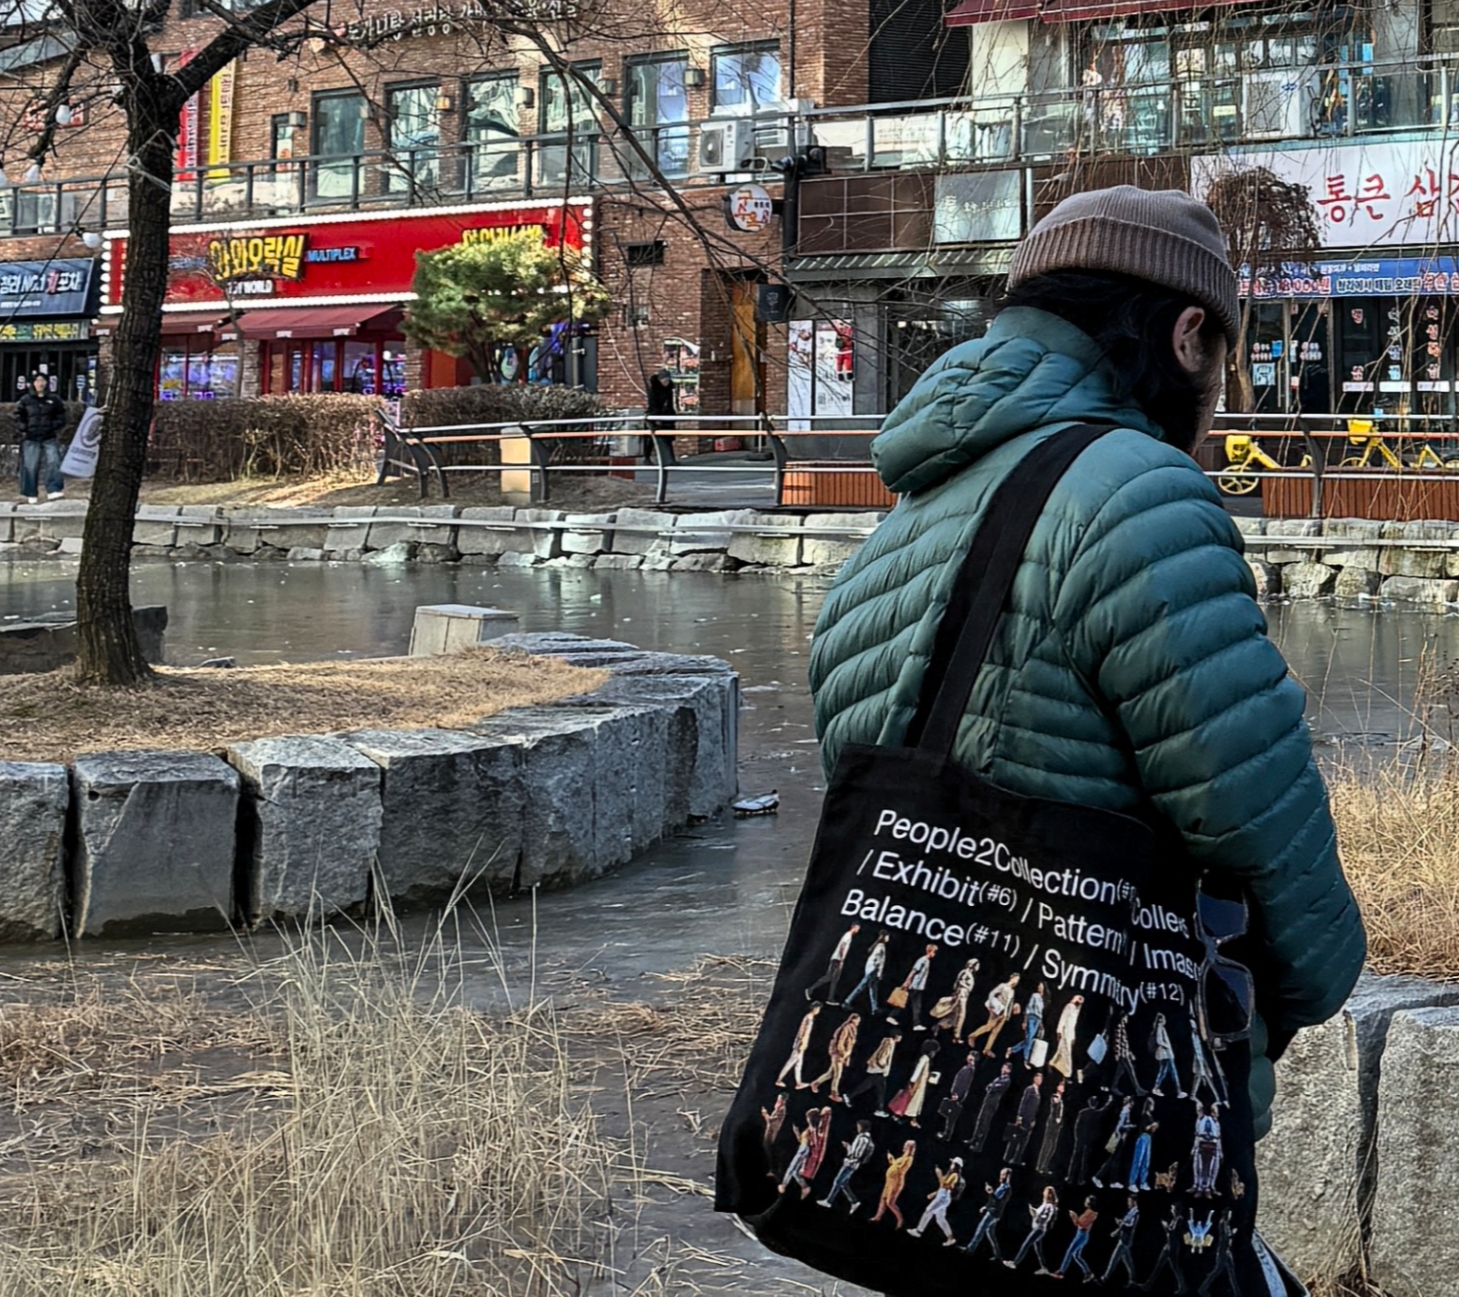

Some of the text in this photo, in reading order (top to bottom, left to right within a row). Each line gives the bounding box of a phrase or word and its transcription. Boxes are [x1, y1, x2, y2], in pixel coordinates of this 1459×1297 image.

[1316, 173, 1391, 223] 통큰
[306, 246, 357, 264] MULTIPLEX
[873, 851, 1018, 913] Exhibit(#6)
[841, 889, 1021, 959] Balance(#11)
